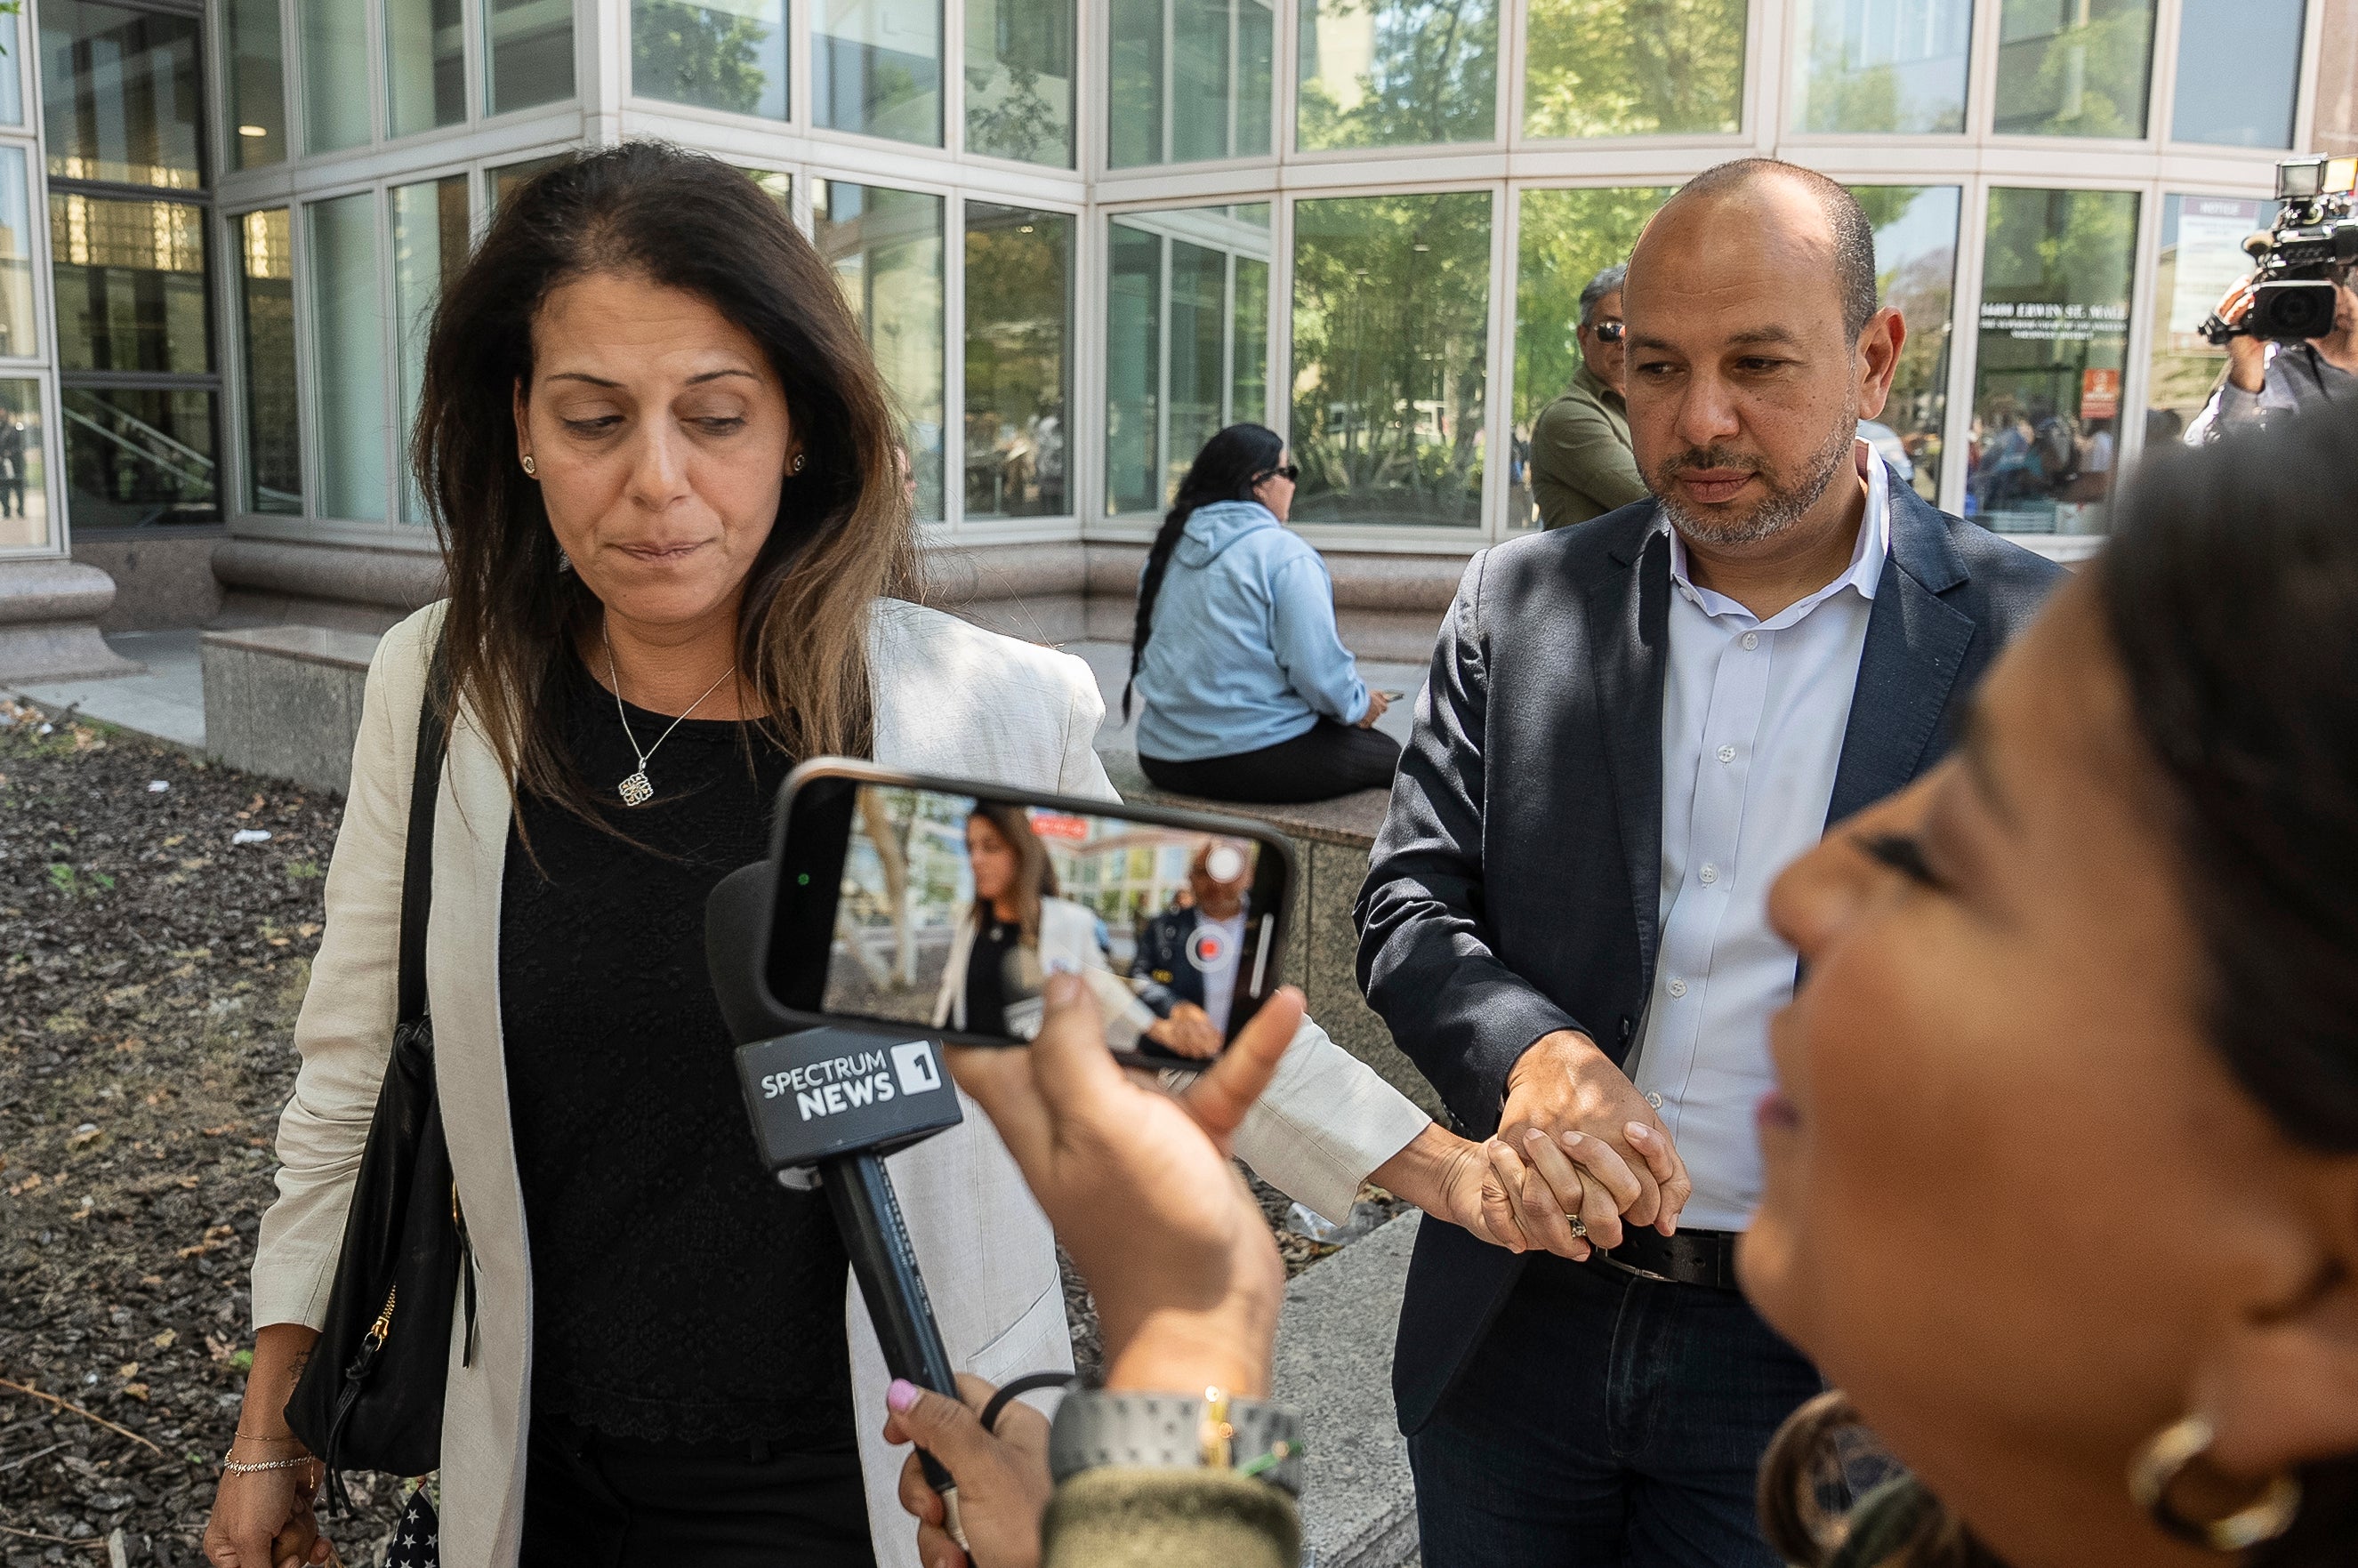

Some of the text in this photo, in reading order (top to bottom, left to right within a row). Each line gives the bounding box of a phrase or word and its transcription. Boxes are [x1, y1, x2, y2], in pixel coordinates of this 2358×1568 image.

[761, 1049, 887, 1099] SPECTRUM
[796, 1053, 932, 1122] NEWS 1
